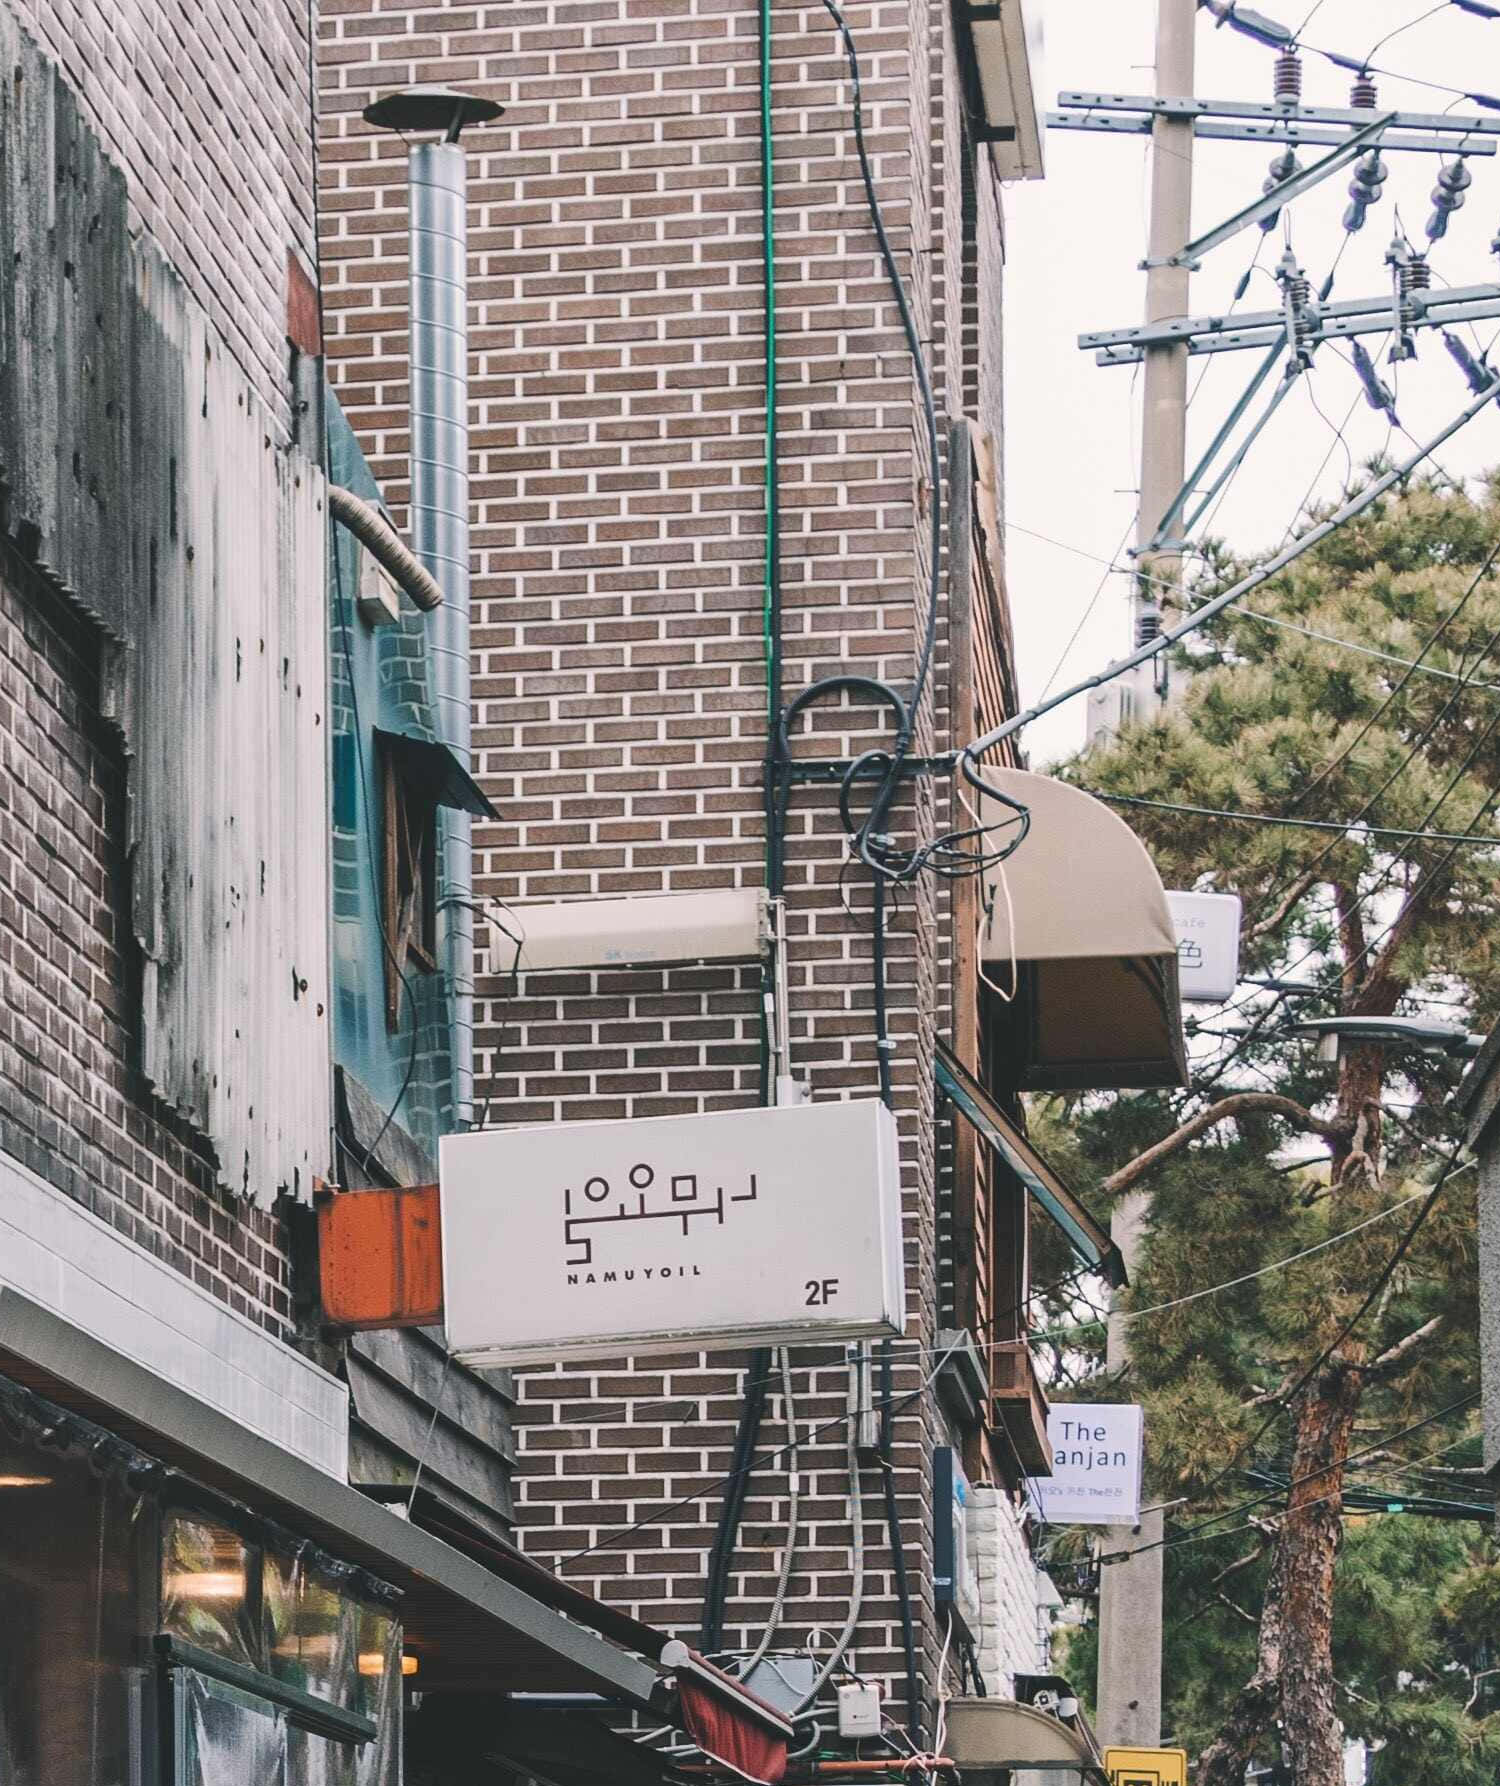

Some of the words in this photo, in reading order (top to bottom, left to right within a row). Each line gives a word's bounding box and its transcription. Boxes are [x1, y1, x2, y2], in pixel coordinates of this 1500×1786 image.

[567, 1264, 701, 1285] NAMUYOIL
[804, 1278, 840, 1306] 2F
[1060, 1421, 1107, 1441] The
[1054, 1446, 1127, 1472] anjan
